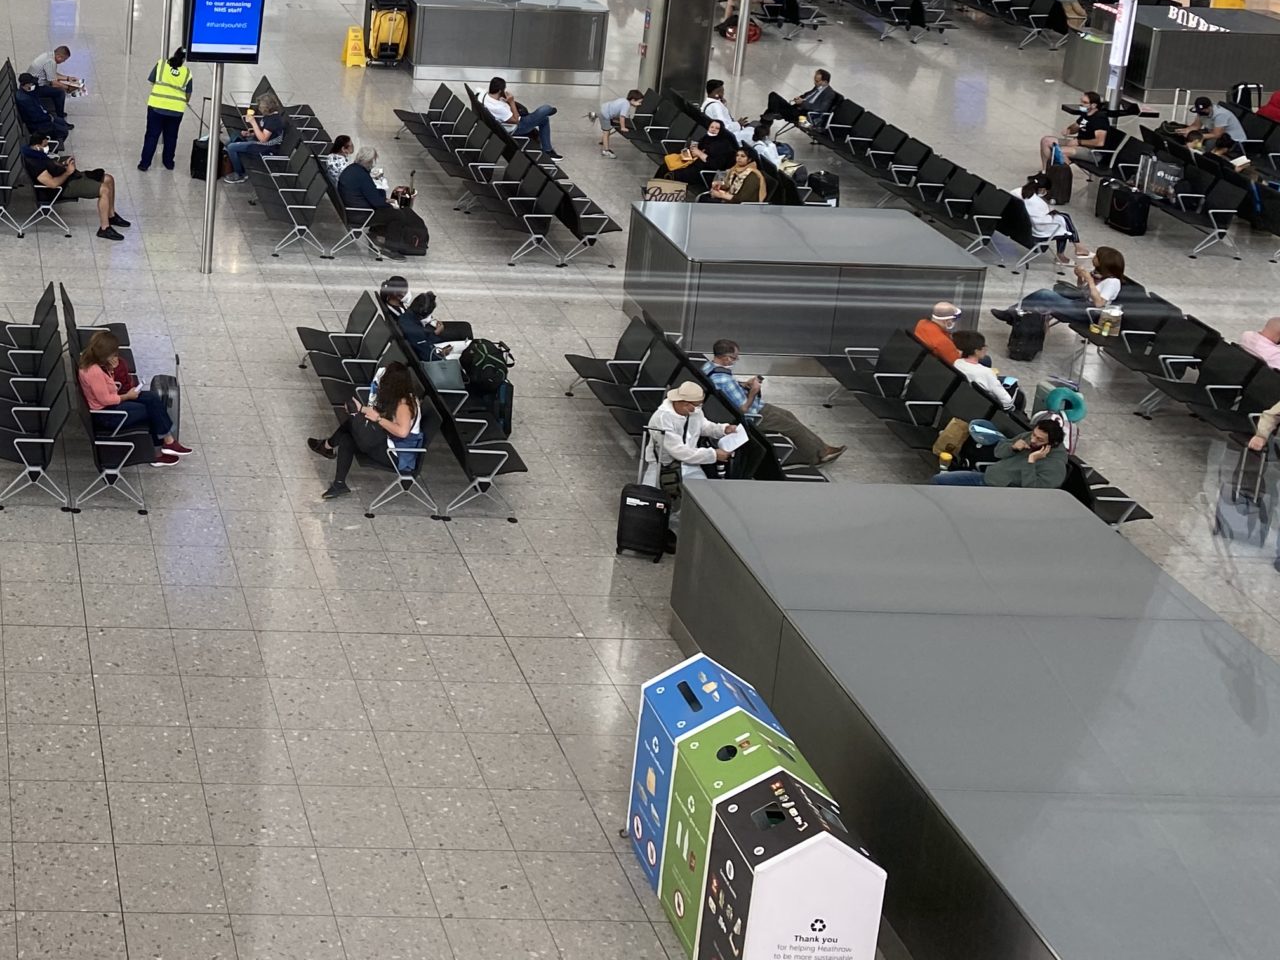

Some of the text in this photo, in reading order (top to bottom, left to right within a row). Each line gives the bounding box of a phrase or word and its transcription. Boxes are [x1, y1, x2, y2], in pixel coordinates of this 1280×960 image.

[794, 934, 838, 945] Thank you
[789, 944, 816, 953] helping
[817, 945, 852, 953] Heathrow
